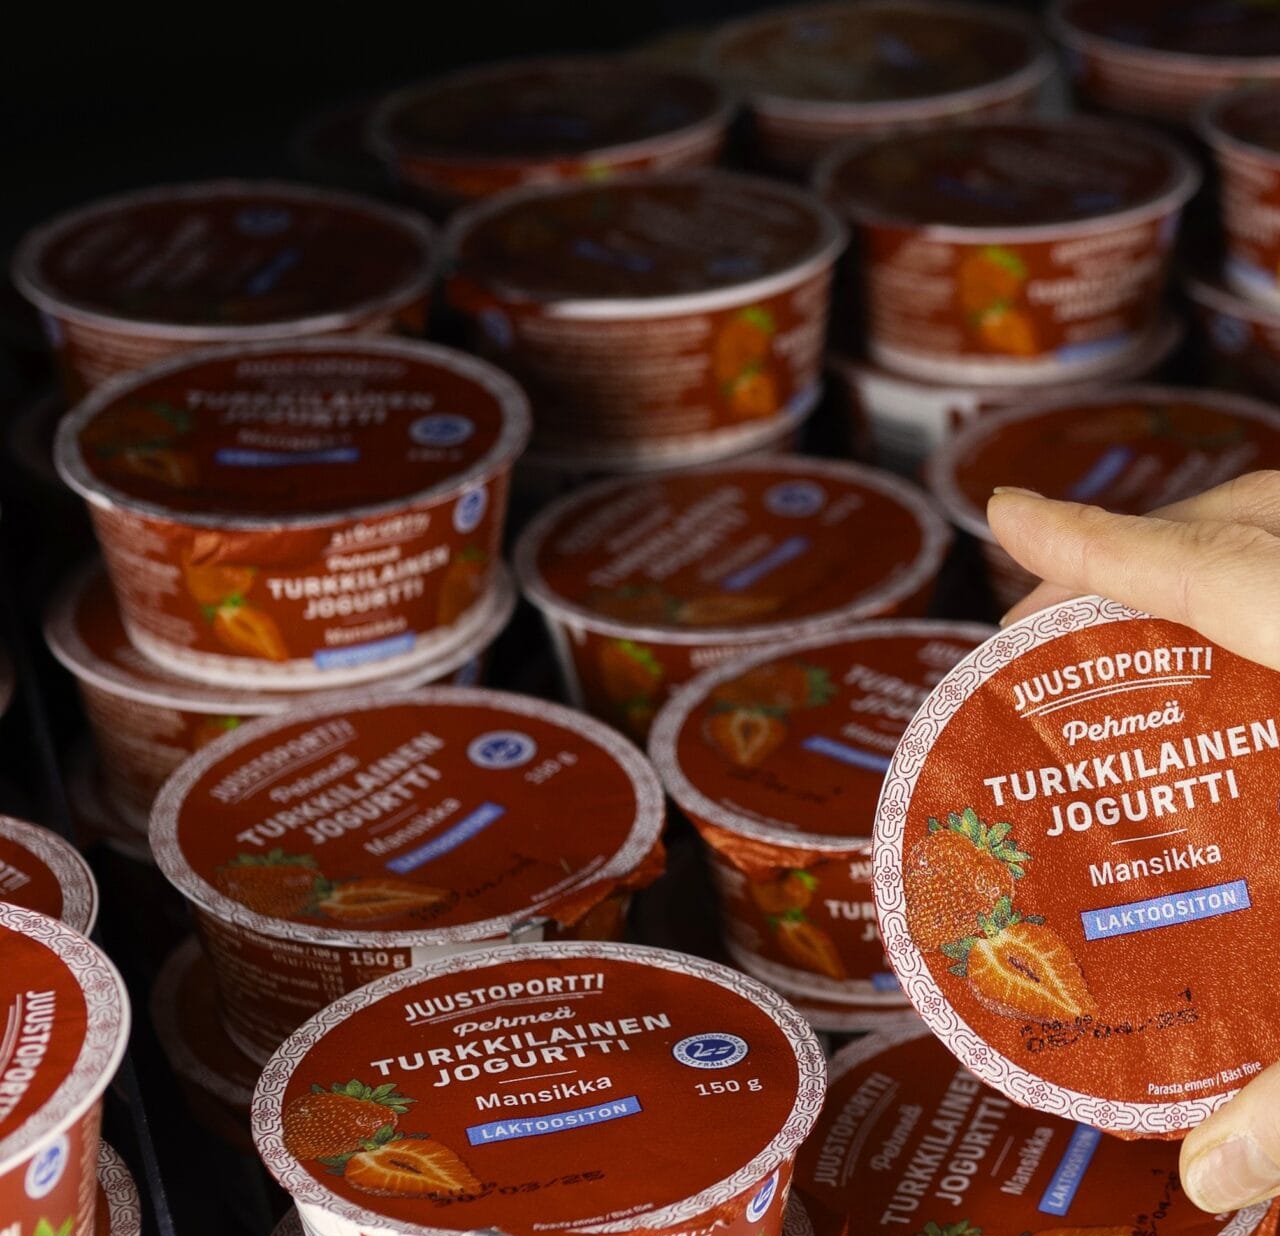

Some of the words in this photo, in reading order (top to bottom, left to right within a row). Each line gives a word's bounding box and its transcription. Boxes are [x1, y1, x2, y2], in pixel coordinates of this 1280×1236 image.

[1012, 646, 1213, 712] JUUSTOPORTTI
[1062, 700, 1185, 746] Pehmeä
[236, 731, 446, 846] TURKKILAINEN
[983, 717, 1280, 807] TURKKILAINEN
[305, 763, 442, 845] JOGURTTI
[1046, 768, 1240, 838] JOGURTTI
[1088, 840, 1223, 887] Mansikka
[1095, 889, 1238, 932] LAKTOOSITON
[350, 951, 389, 967] 150
[392, 953, 406, 969] g
[404, 972, 606, 1022] JUUSTOPORTTI
[452, 1006, 576, 1038] Pehmeä
[0, 990, 55, 1123] JUUSTOPORT
[370, 1012, 672, 1077] TURKKILAINEN
[432, 1038, 632, 1088] JOGURTTI
[1147, 1079, 1183, 1094] Parasta
[1184, 1074, 1214, 1090] ennen
[1221, 1066, 1243, 1084] Bäst
[1242, 1060, 1263, 1078] före
[475, 1073, 613, 1111] Mansikka
[695, 1079, 739, 1097] 150
[746, 1077, 764, 1092] g
[482, 1102, 629, 1140] LAKTOOSITON
[813, 1072, 894, 1188] JUUSTOPORTTI
[869, 1103, 924, 1171] Pehmeä
[935, 1095, 1012, 1206] JOGURTTI
[1000, 1126, 1055, 1196] Mansikka
[1047, 1128, 1097, 1209] LAKTOOSITON
